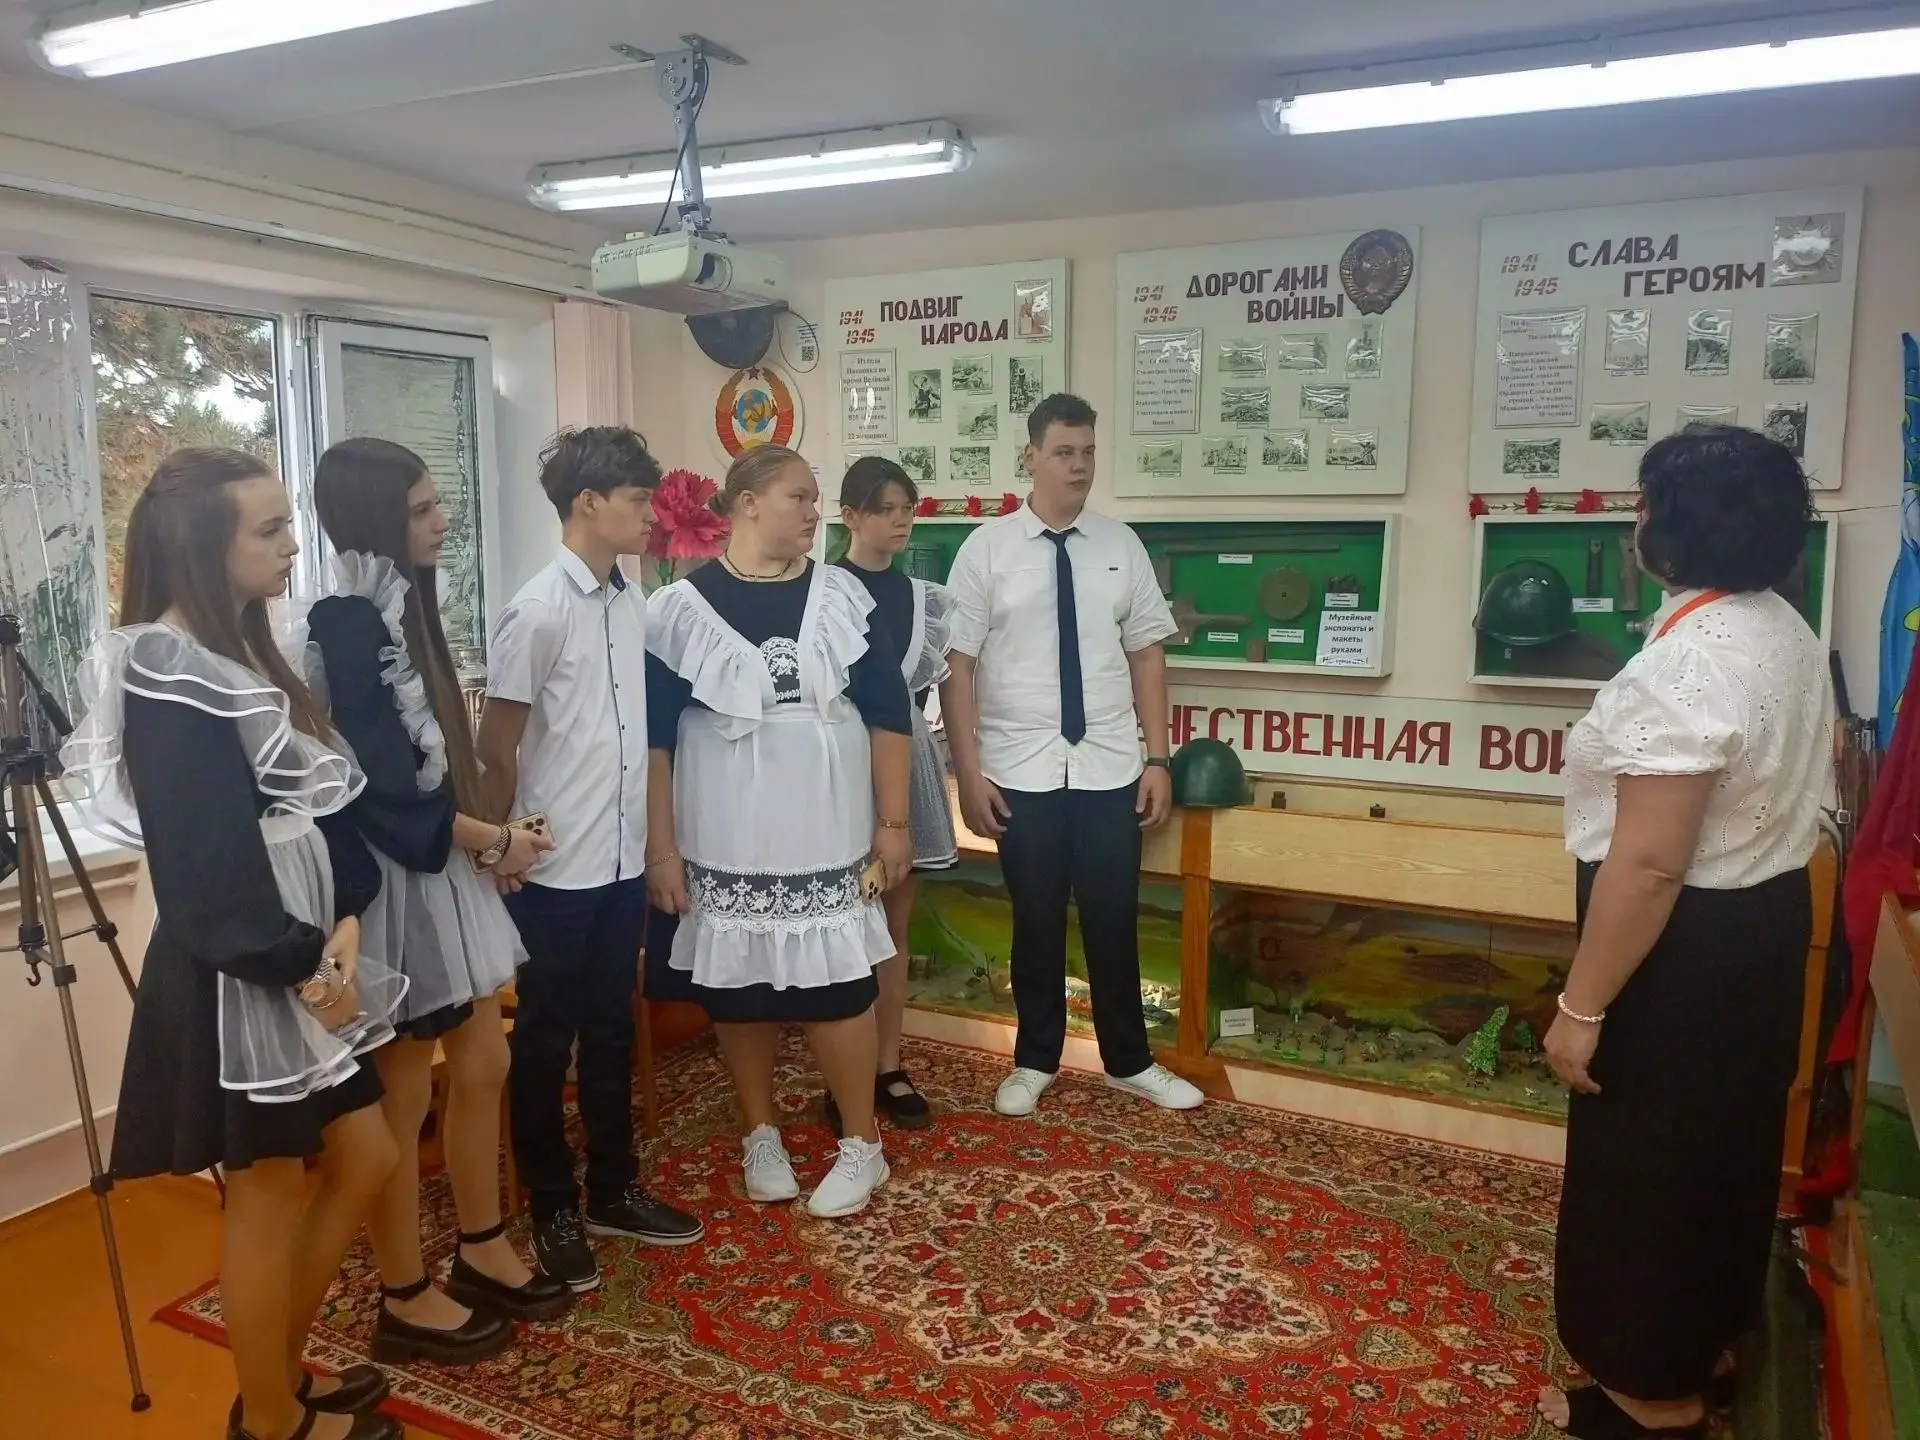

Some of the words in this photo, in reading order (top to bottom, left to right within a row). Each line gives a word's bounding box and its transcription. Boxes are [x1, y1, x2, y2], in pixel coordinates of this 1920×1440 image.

[1568, 234, 1679, 268] СЛАВА
[1501, 254, 1540, 273] 1941
[1186, 265, 1328, 298] ДОРОГАМИ
[1514, 277, 1559, 297] 1945
[1623, 262, 1765, 297] ГЕРОЯМ
[1134, 285, 1164, 302] 1941
[880, 295, 963, 322] ПОДВИГ
[1143, 306, 1178, 323] 1945
[1247, 291, 1344, 323] ВОЙНЫ
[839, 310, 864, 325] 1941
[846, 328, 875, 344] 1945
[921, 319, 1009, 345] НАРОДА
[1328, 613, 1372, 622] Музейные
[1323, 625, 1367, 633] экспонаты
[1331, 635, 1364, 643] макеты
[1331, 646, 1362, 655] руками
